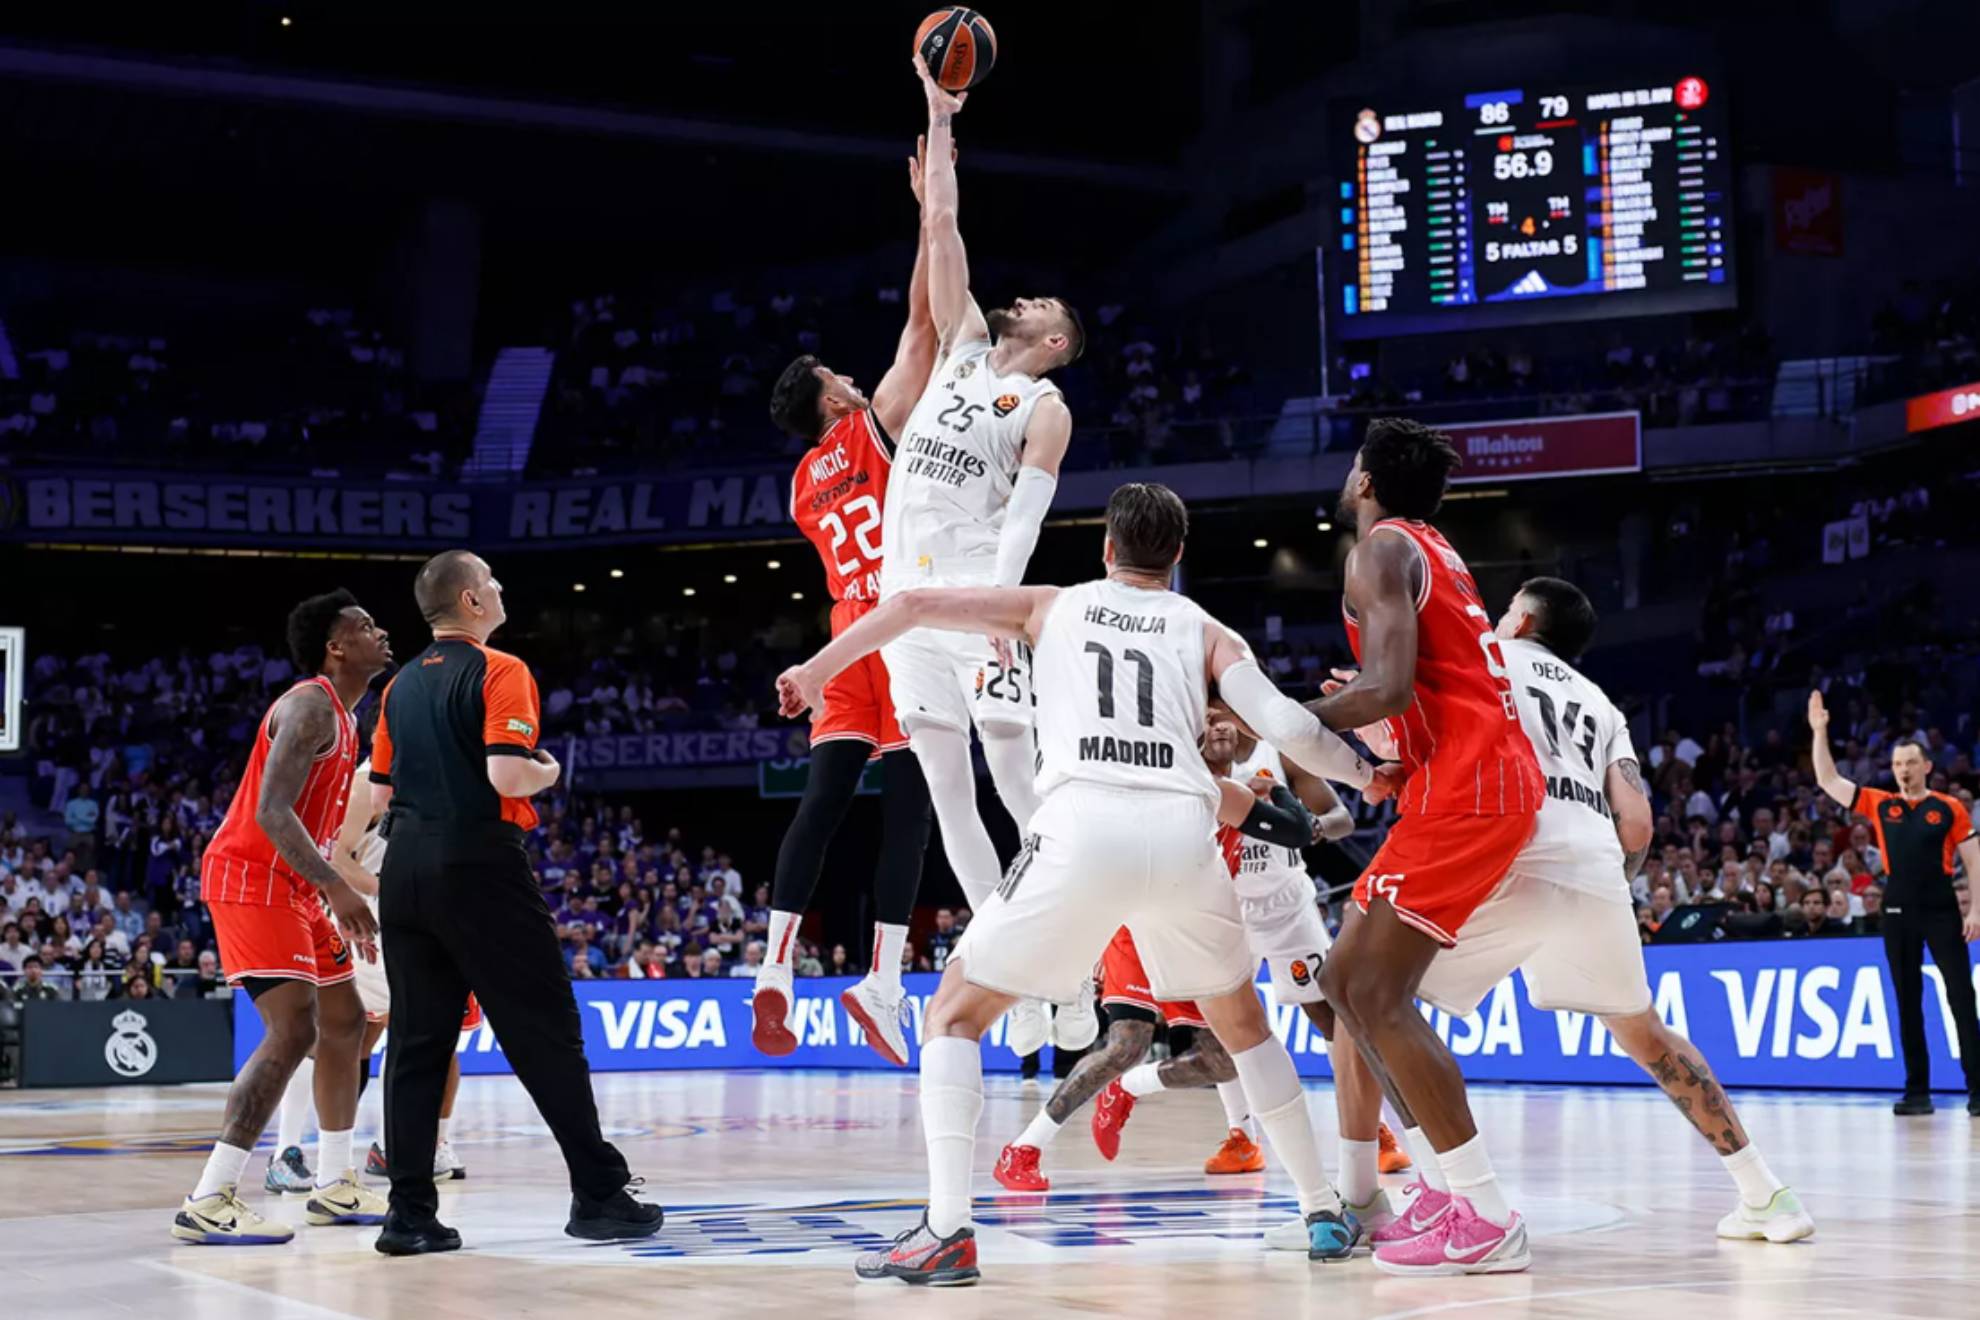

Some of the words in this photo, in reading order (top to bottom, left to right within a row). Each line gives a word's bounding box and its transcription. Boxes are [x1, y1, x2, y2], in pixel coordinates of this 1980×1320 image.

[1539, 95, 1569, 118] 79
[1494, 150, 1553, 180] 56.9
[1520, 215, 1536, 236] 4
[1485, 241, 1500, 262] 5
[1563, 234, 1578, 255] 5
[937, 394, 986, 433] 25
[809, 442, 850, 486] MICIĆ
[906, 432, 988, 478] Emirates
[1465, 433, 1544, 456] Mahou
[27, 476, 473, 540] BERSERKERS
[508, 483, 665, 540] REAL
[818, 495, 884, 577] 22
[1083, 604, 1168, 635] HEZONJA
[986, 660, 1022, 704] 25
[1083, 640, 1154, 728] 11
[544, 729, 781, 767] RSERKERS
[1525, 685, 1597, 772] 14
[1078, 735, 1175, 770] MADRID
[587, 998, 728, 1050] VISA
[1709, 965, 1895, 1060] VISA
